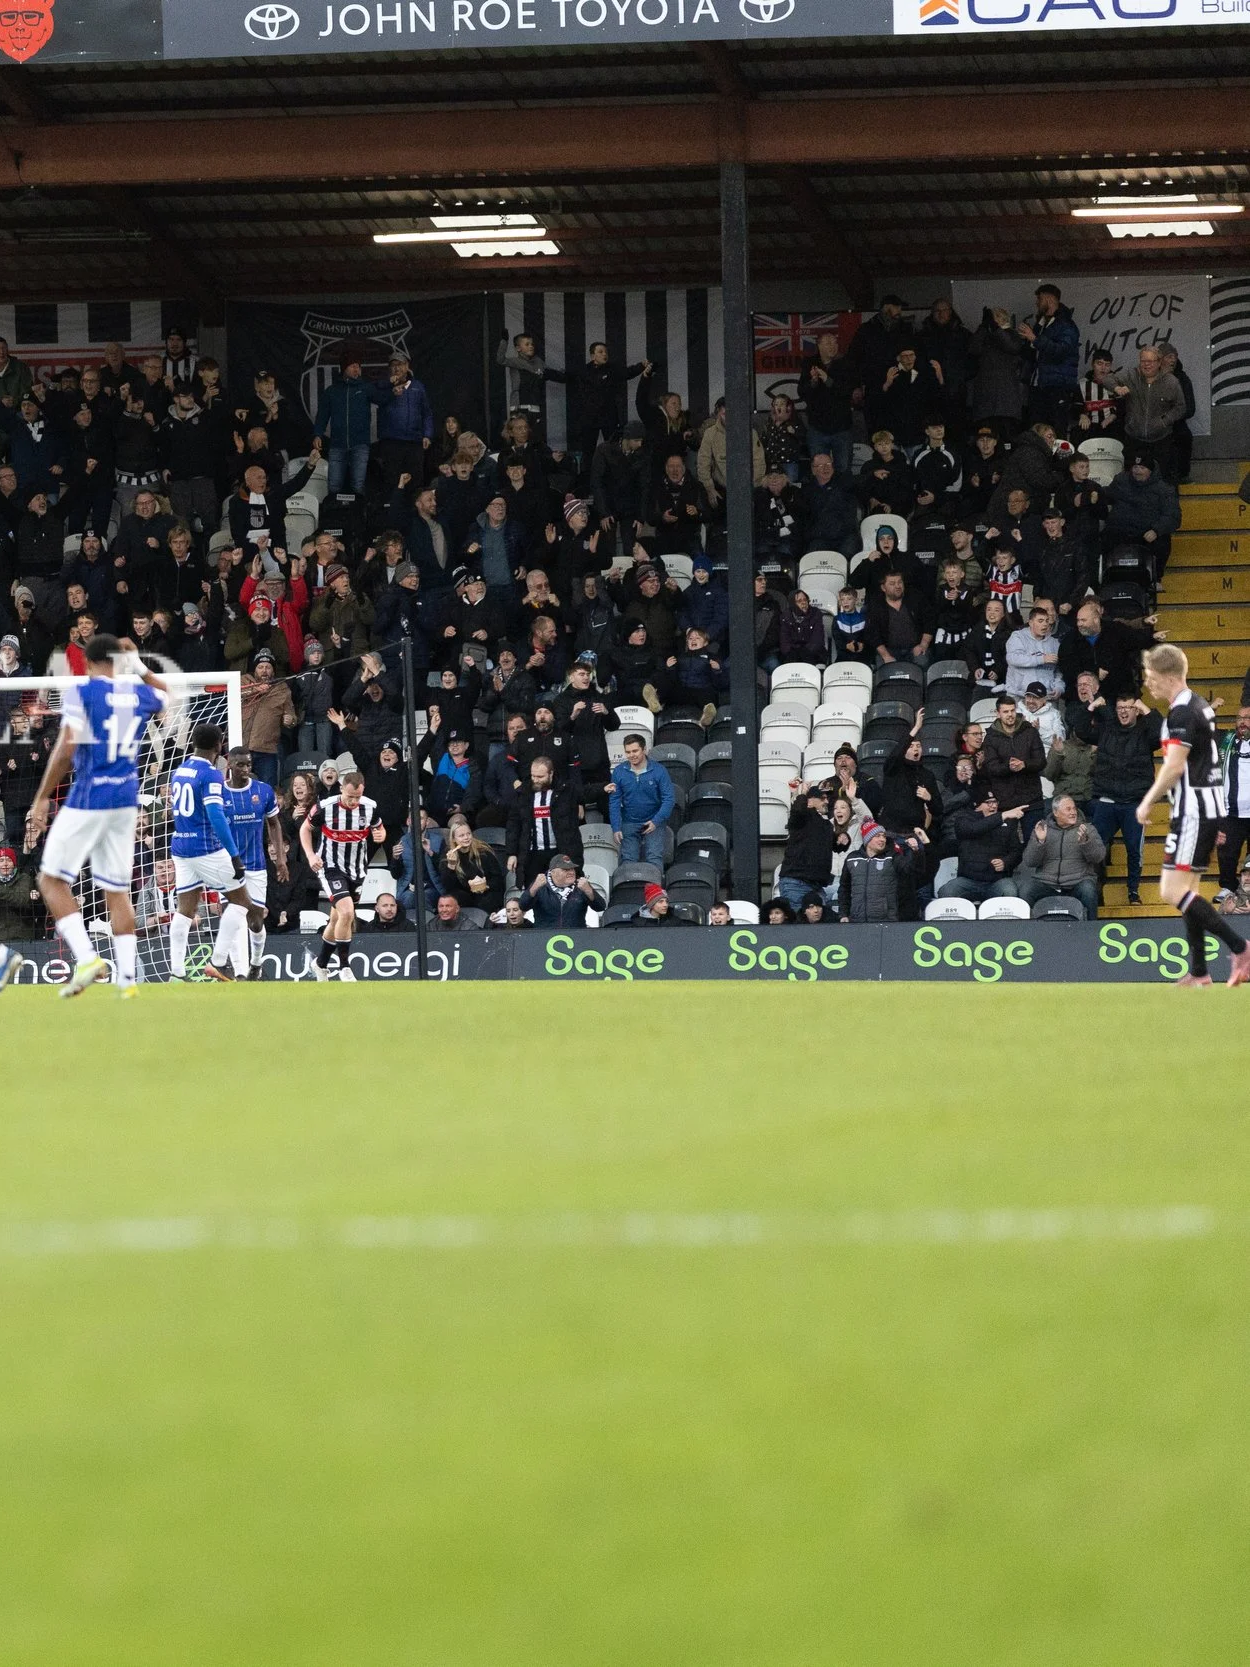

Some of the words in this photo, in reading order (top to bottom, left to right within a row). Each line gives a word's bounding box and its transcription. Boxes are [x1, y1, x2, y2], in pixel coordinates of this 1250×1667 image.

[319, 1, 436, 37] JOHN
[454, 0, 536, 31] ROE
[552, 0, 719, 28] TOYOTA
[1150, 293, 1184, 320] OF
[308, 320, 354, 334] GRIMSBY
[355, 322, 388, 334] TOWN
[1238, 504, 1247, 517] P
[1230, 540, 1238, 552] N
[1222, 577, 1233, 590] M
[1217, 615, 1225, 627] L
[1211, 652, 1220, 665] K
[102, 713, 142, 763] 14
[172, 782, 195, 818] 20
[233, 812, 256, 820] Brunel
[1164, 833, 1178, 854] 5
[545, 935, 664, 981] Sage
[728, 930, 849, 982] Sage
[913, 926, 1035, 982] Sage
